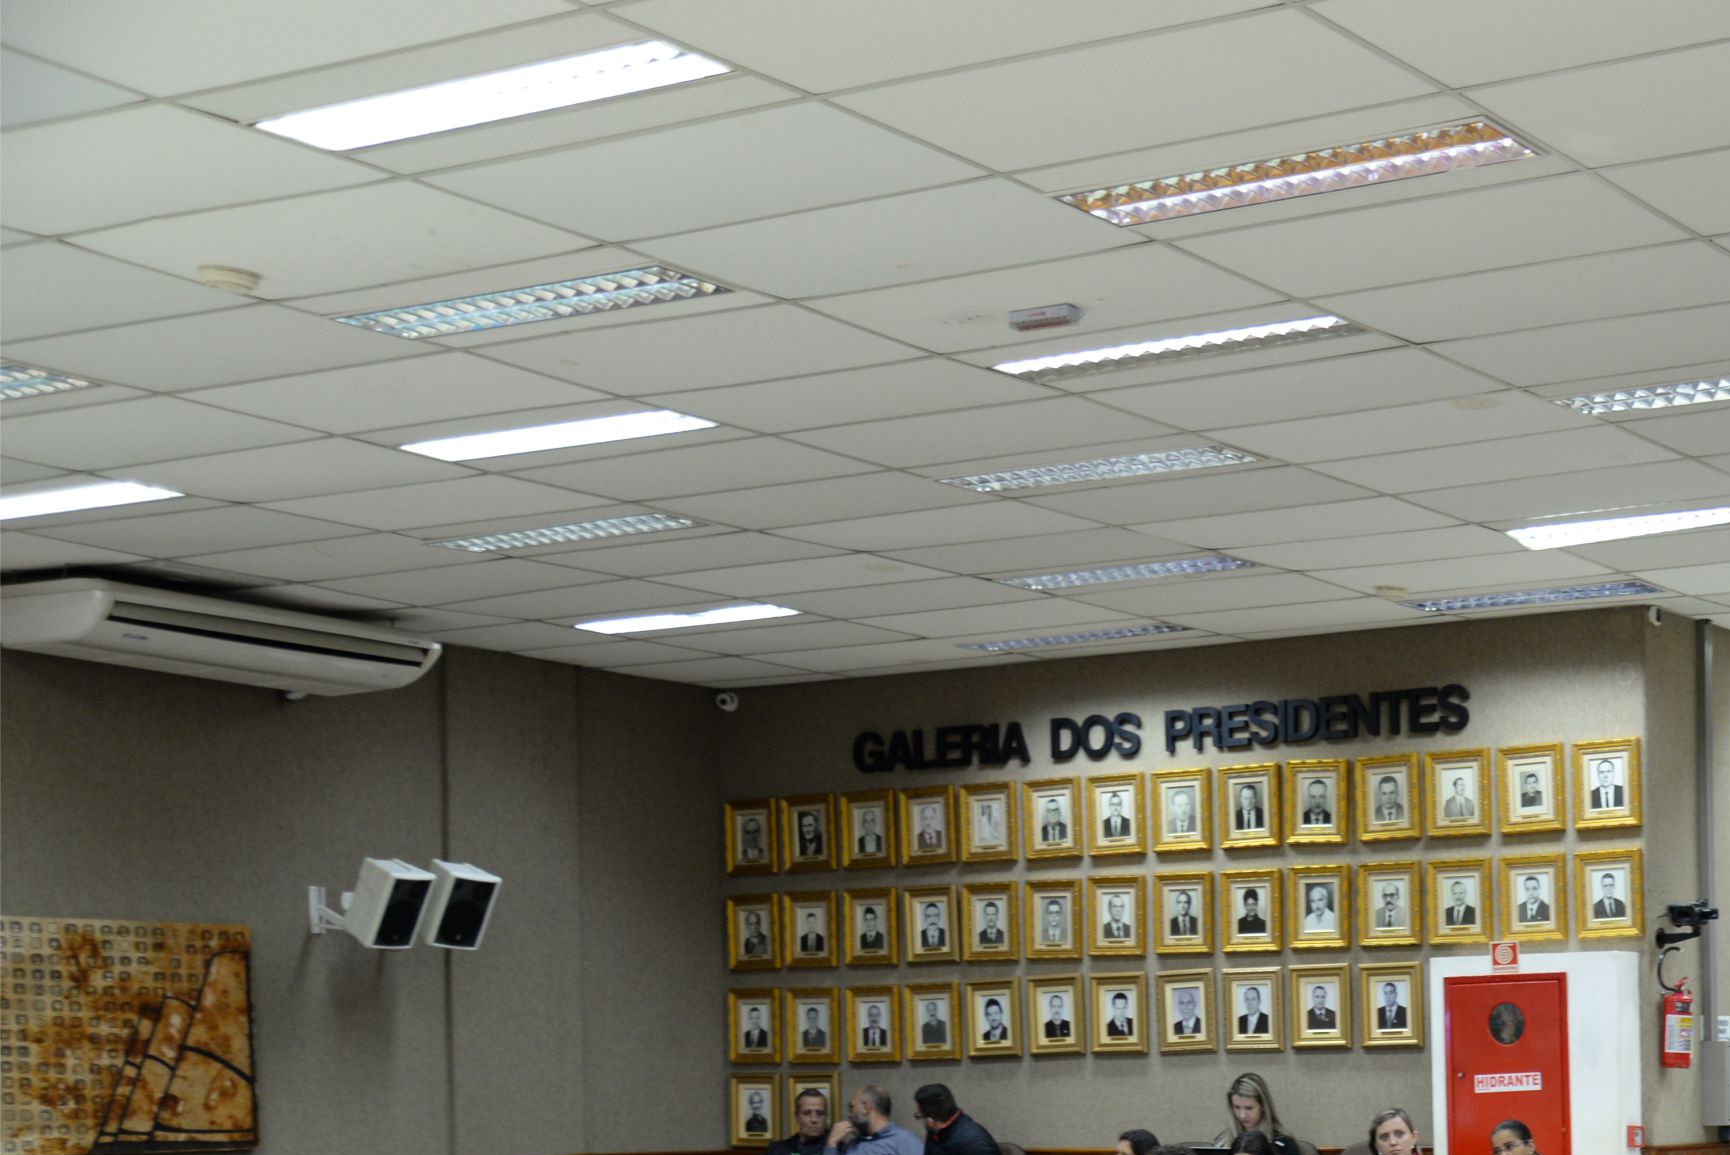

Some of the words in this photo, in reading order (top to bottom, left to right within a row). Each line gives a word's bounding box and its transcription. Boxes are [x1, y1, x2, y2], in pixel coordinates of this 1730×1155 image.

[854, 721, 1030, 773] GALERIA
[1050, 711, 1142, 761] DOS
[1165, 683, 1470, 753] PRESIDENTES
[1475, 1073, 1541, 1091] HIDRANTE
